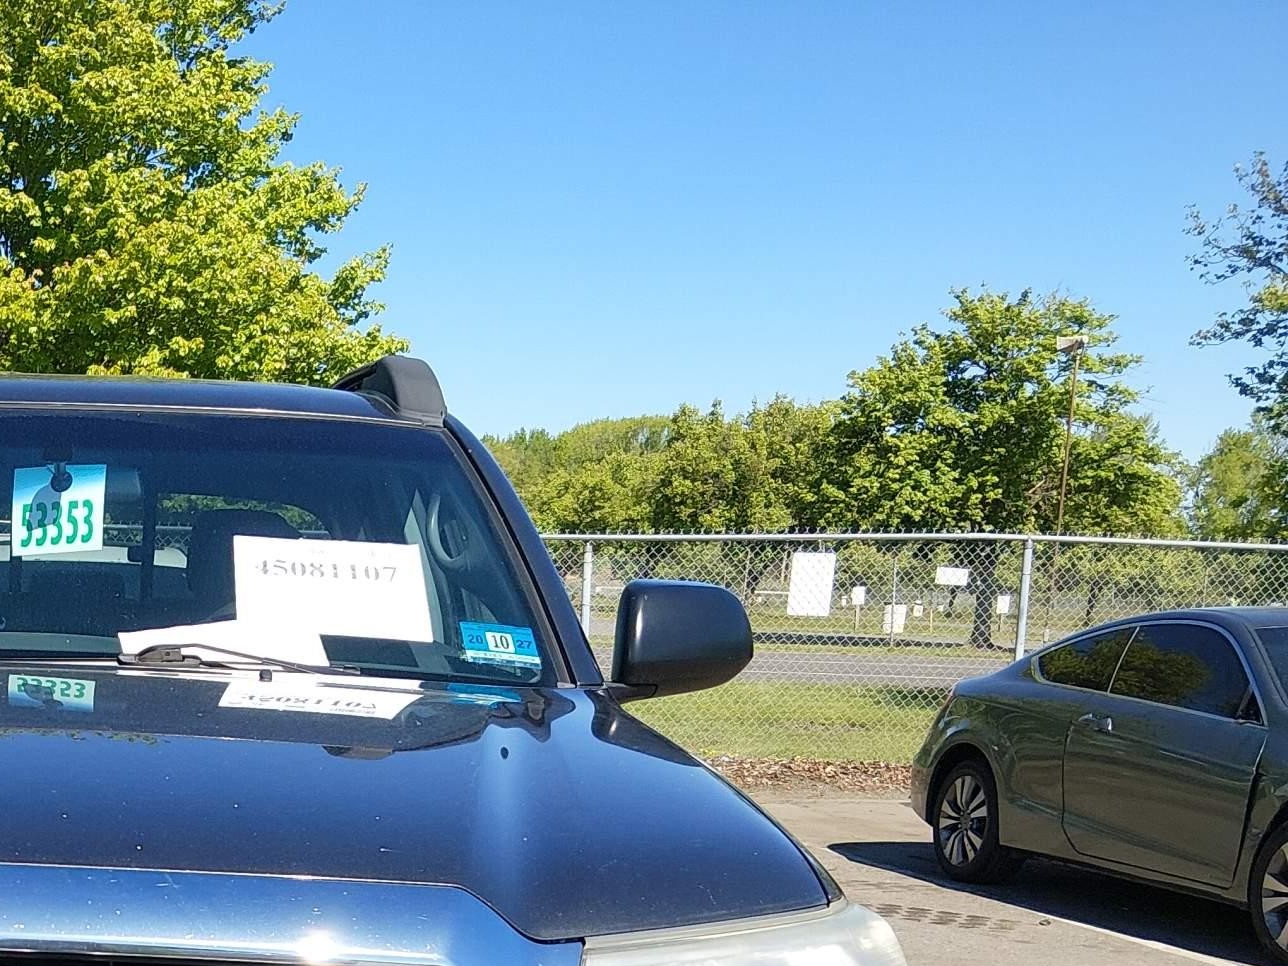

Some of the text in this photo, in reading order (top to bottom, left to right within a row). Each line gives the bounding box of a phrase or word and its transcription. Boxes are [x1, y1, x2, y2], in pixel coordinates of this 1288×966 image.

[20, 499, 94, 548] 53353
[254, 559, 397, 583] 45081107
[467, 634, 532, 650] 20 10 27
